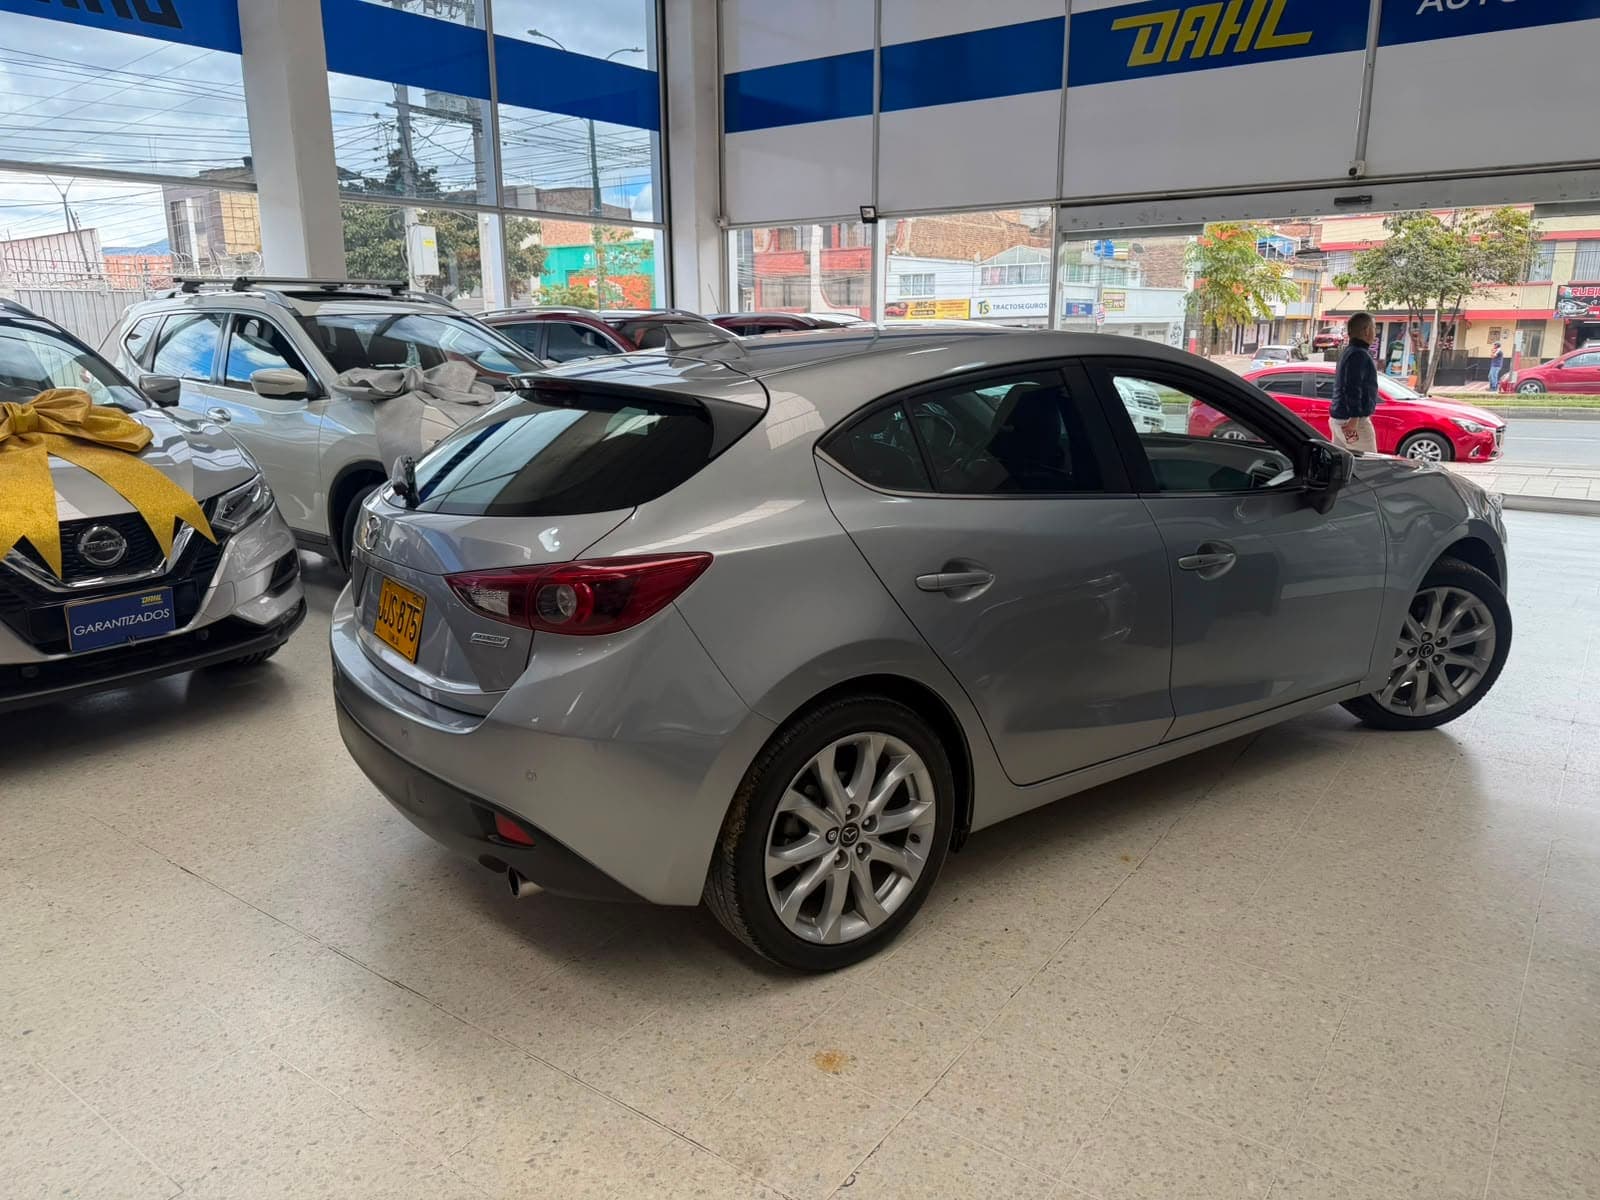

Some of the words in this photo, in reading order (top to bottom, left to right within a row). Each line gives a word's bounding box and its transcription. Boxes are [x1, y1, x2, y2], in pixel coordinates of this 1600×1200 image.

[1111, 0, 1313, 67] DAHL
[1571, 287, 1600, 298] RUBI
[73, 608, 170, 636] GARANTIZADOS
